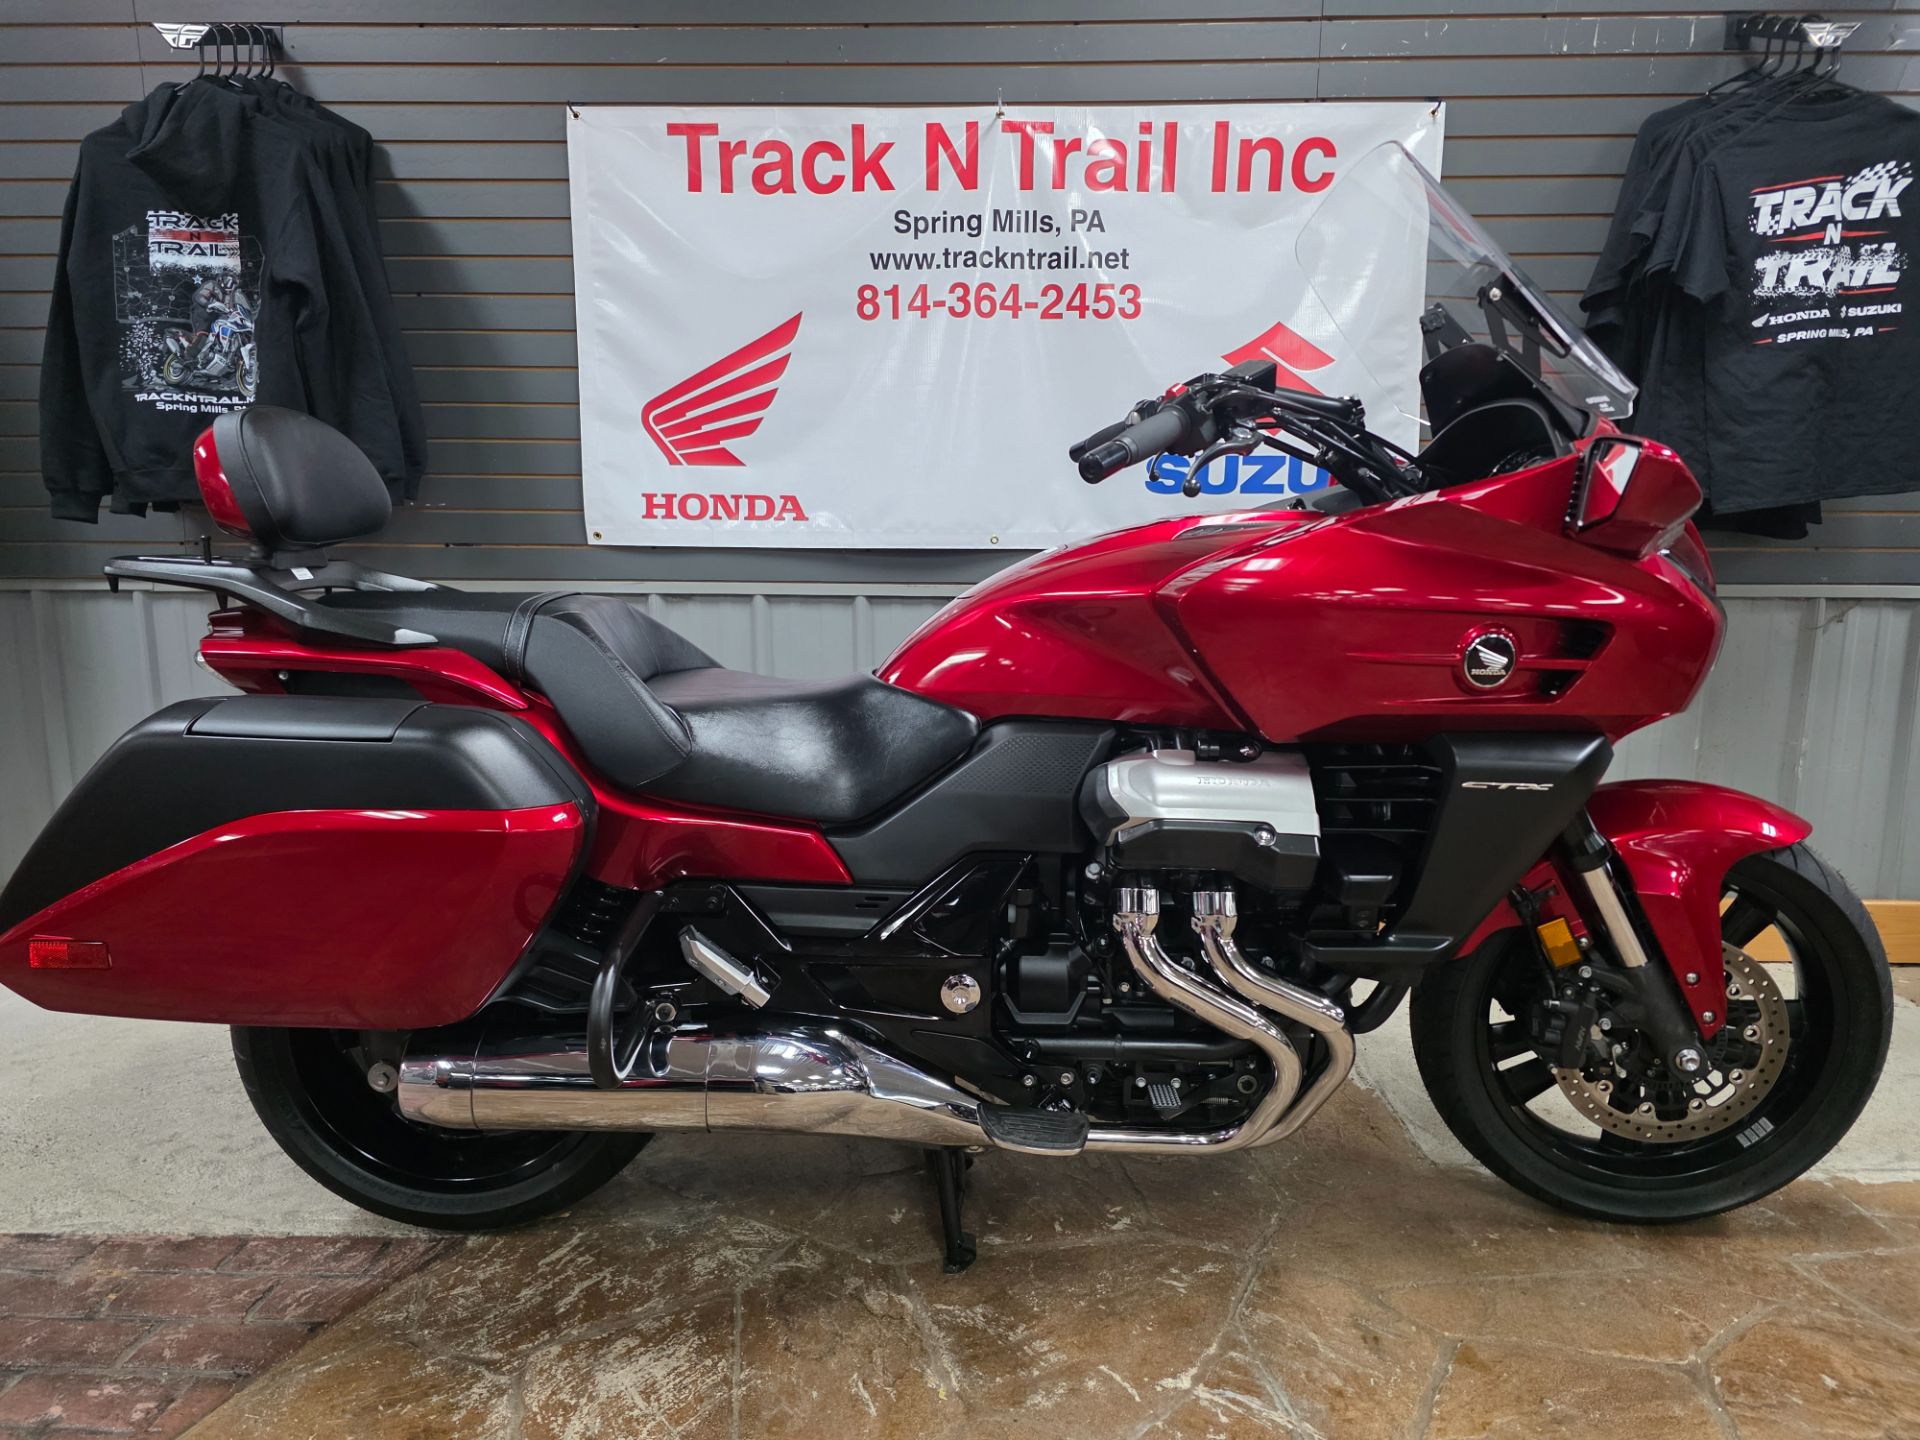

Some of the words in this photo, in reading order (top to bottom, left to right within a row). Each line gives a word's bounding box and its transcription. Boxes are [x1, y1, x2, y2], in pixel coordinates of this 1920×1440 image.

[667, 122, 896, 196] Track
[926, 121, 979, 192] N
[1001, 120, 1178, 193] Trail
[1211, 120, 1337, 194] Inc
[1750, 176, 1913, 235] TRACK
[148, 213, 239, 230] TRACK
[893, 209, 982, 238] Spring
[992, 209, 1061, 238] Mills,
[1070, 210, 1106, 233] PA
[189, 231, 201, 242] N
[1823, 223, 1842, 245] N
[150, 241, 228, 257] TRAIL
[869, 245, 1130, 271] www.trackntrail.net
[856, 283, 1142, 320] 814-364-2453
[1768, 308, 1831, 325] HONDA
[1848, 304, 1903, 317] SUZUKI
[1776, 328, 1827, 344] SPRING
[1854, 326, 1874, 337] PA
[155, 401, 198, 414] Spring
[642, 493, 808, 521] HONDA
[1470, 668, 1507, 676] HONDA
